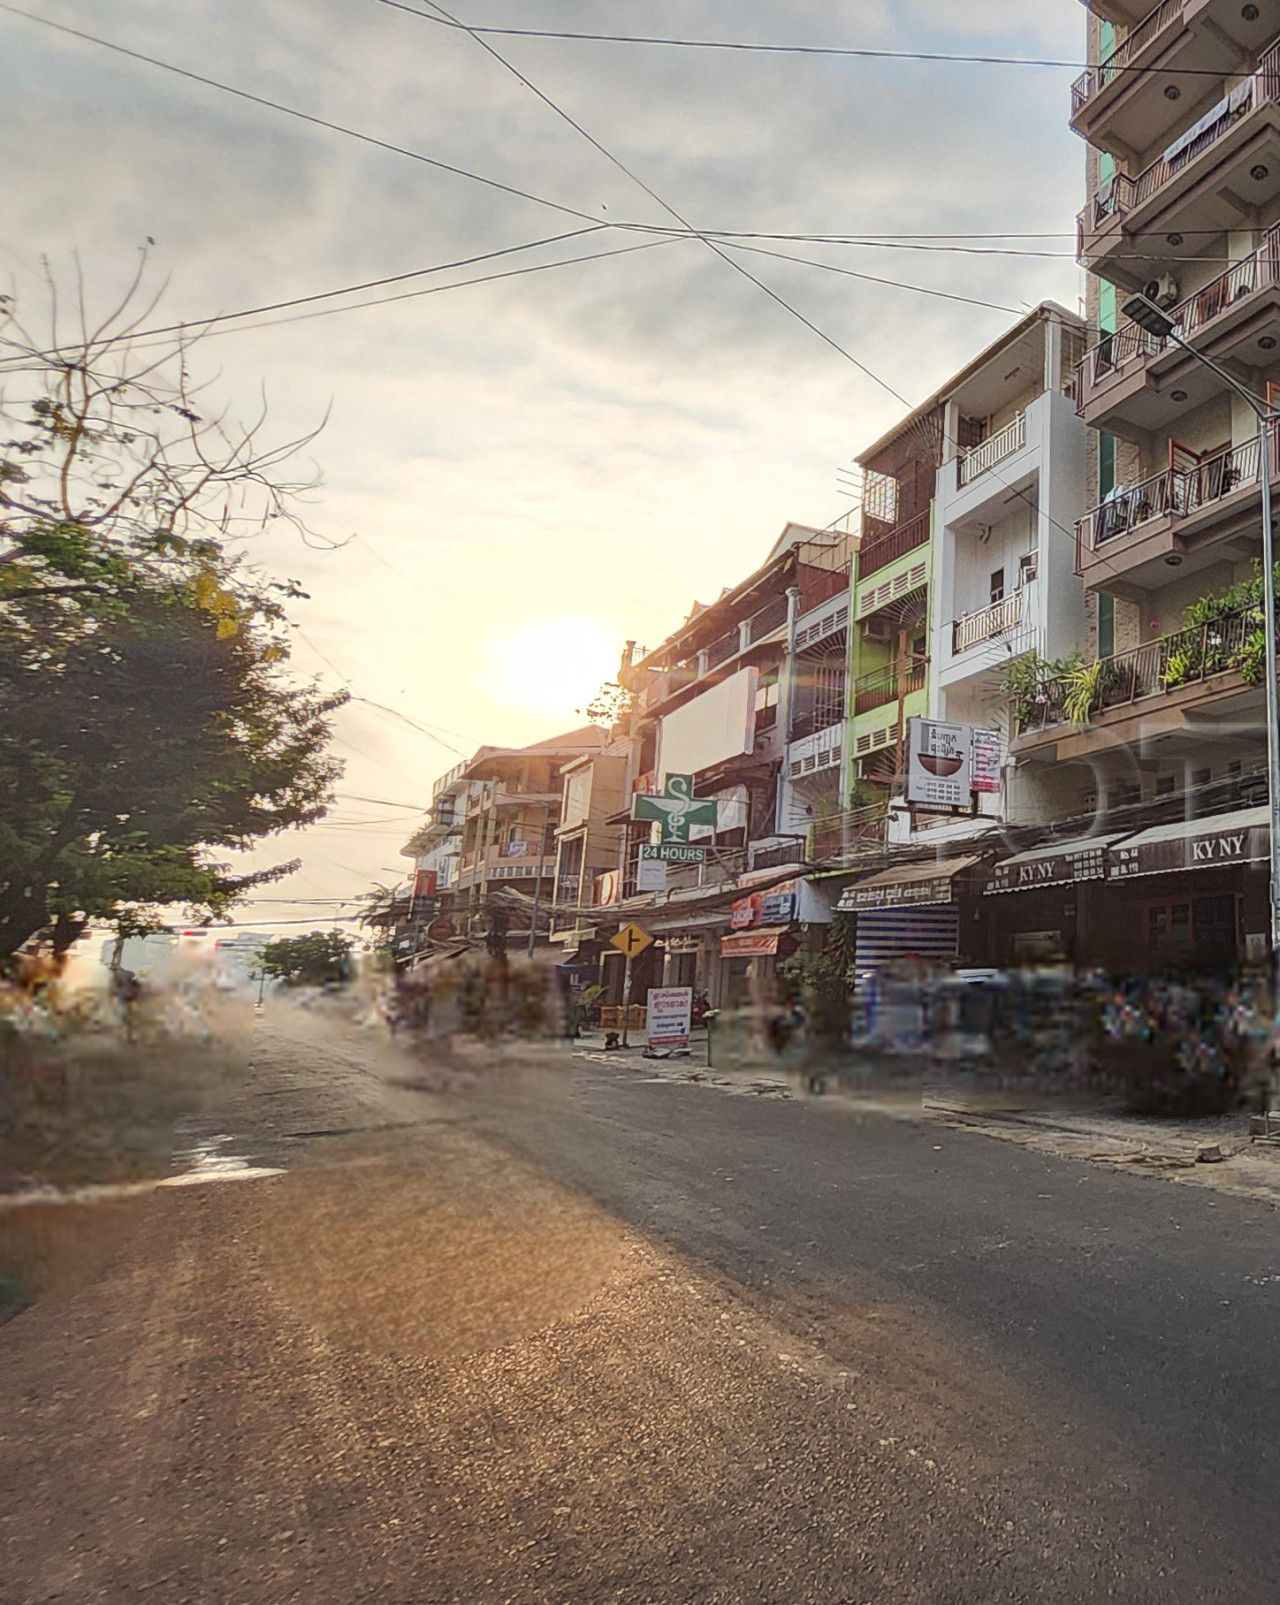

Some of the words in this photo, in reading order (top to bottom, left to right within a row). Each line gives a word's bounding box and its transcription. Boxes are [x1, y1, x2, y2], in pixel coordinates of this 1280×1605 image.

[643, 846, 657, 859] 24
[660, 847, 704, 861] HOURS
[1193, 840, 1217, 861] KY
[1220, 834, 1245, 855] NY
